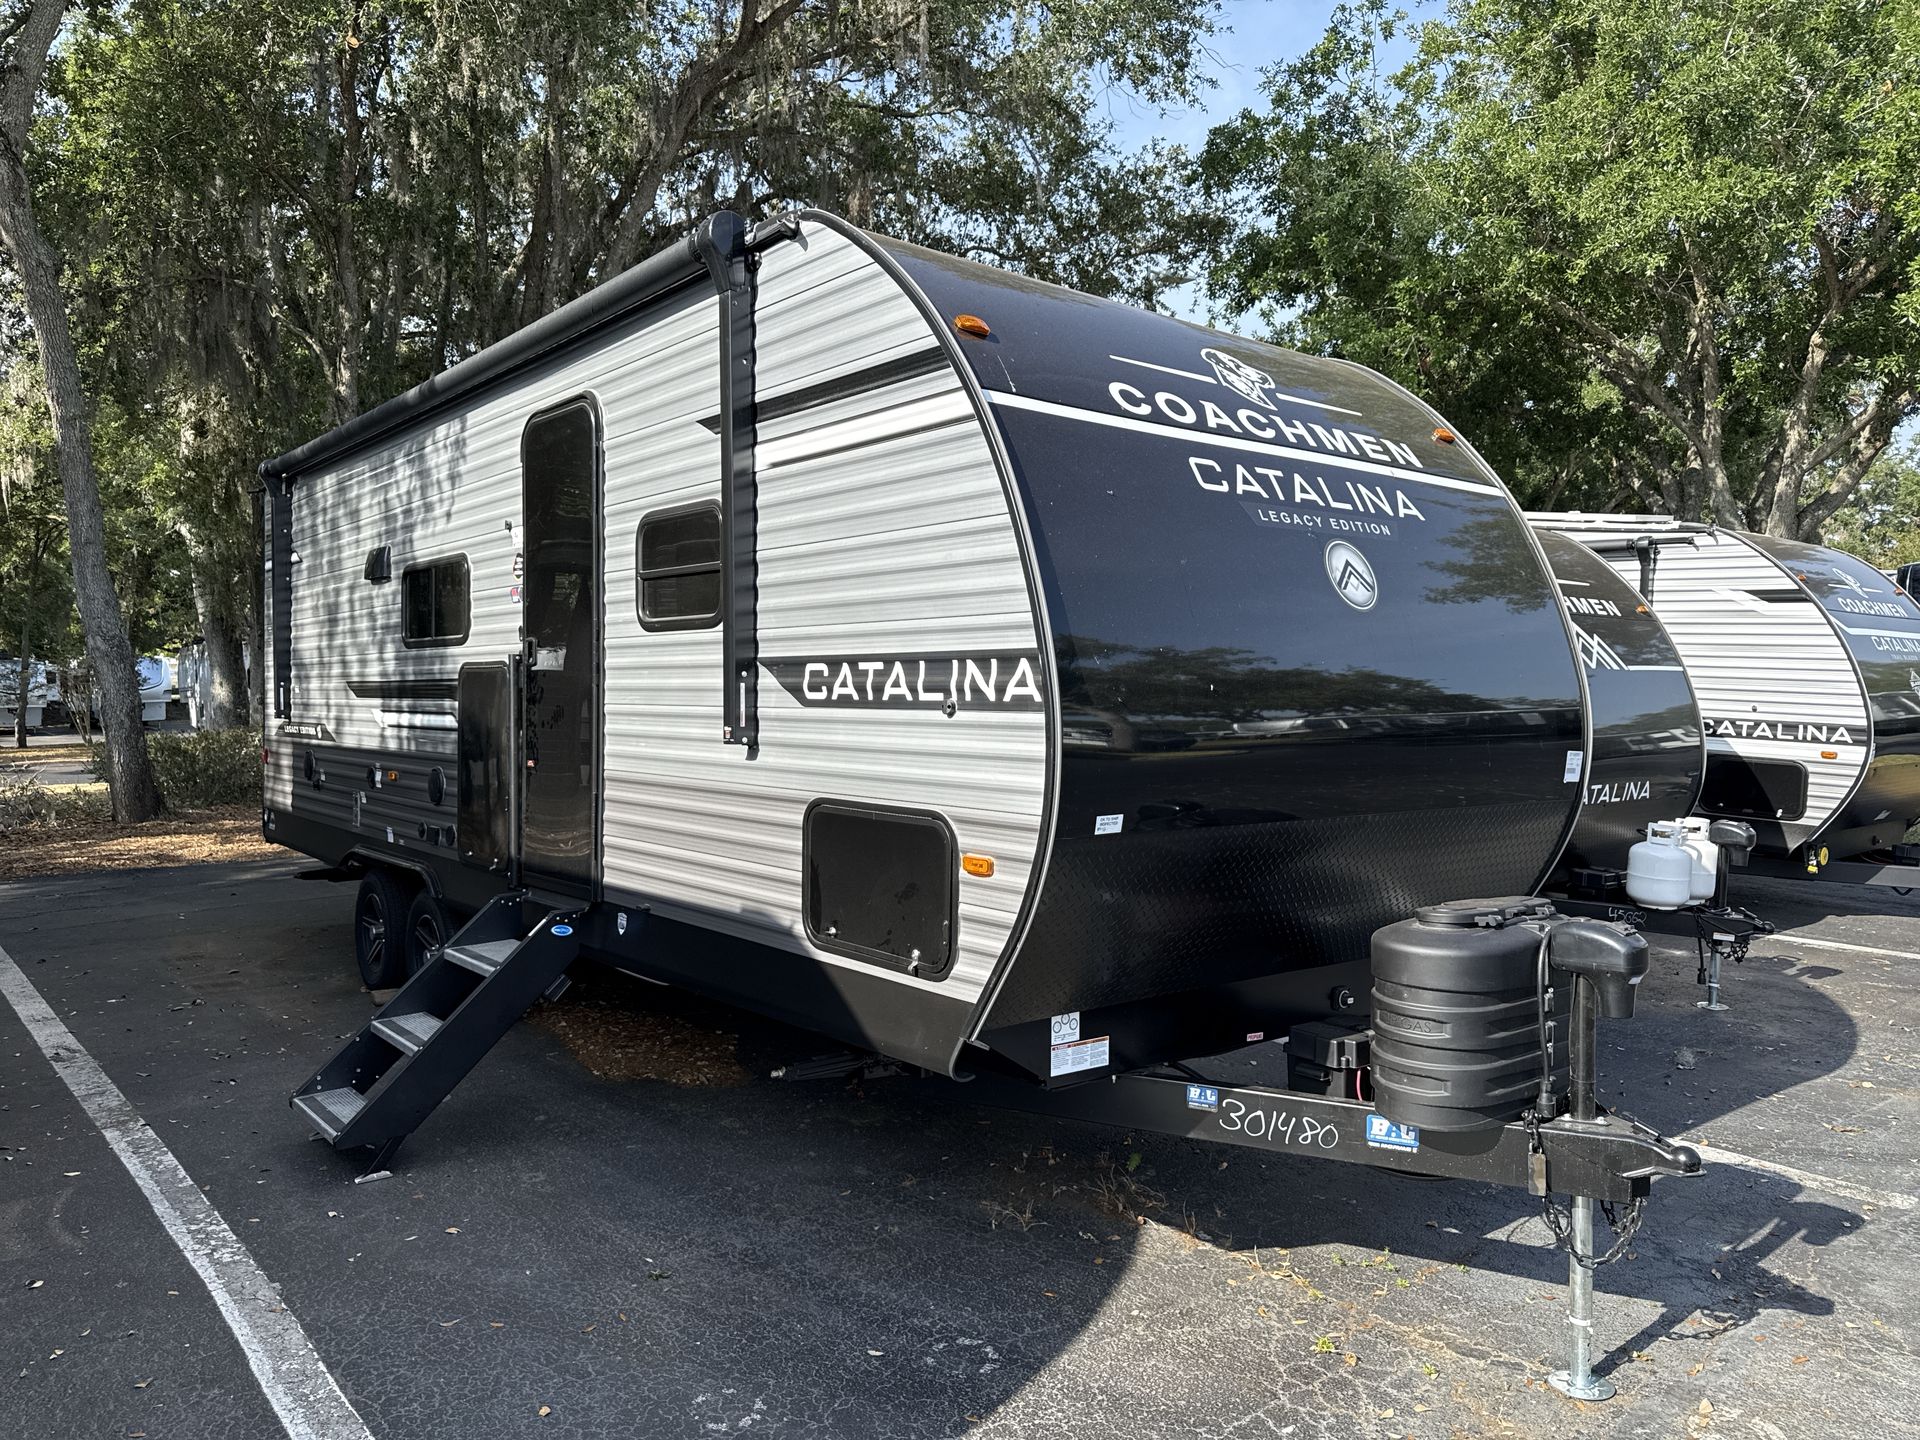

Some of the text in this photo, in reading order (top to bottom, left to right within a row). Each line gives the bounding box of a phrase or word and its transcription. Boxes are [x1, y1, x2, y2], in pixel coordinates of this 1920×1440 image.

[1108, 382, 1423, 469] COACHMEN
[1188, 457, 1426, 521] CATALINA
[1258, 509, 1391, 536] LEGACY EDITION
[1838, 597, 1908, 618] COACHMEN
[802, 658, 1042, 702] CATALINA
[1703, 719, 1853, 743] CATALINA
[1219, 1099, 1338, 1149] 301480
